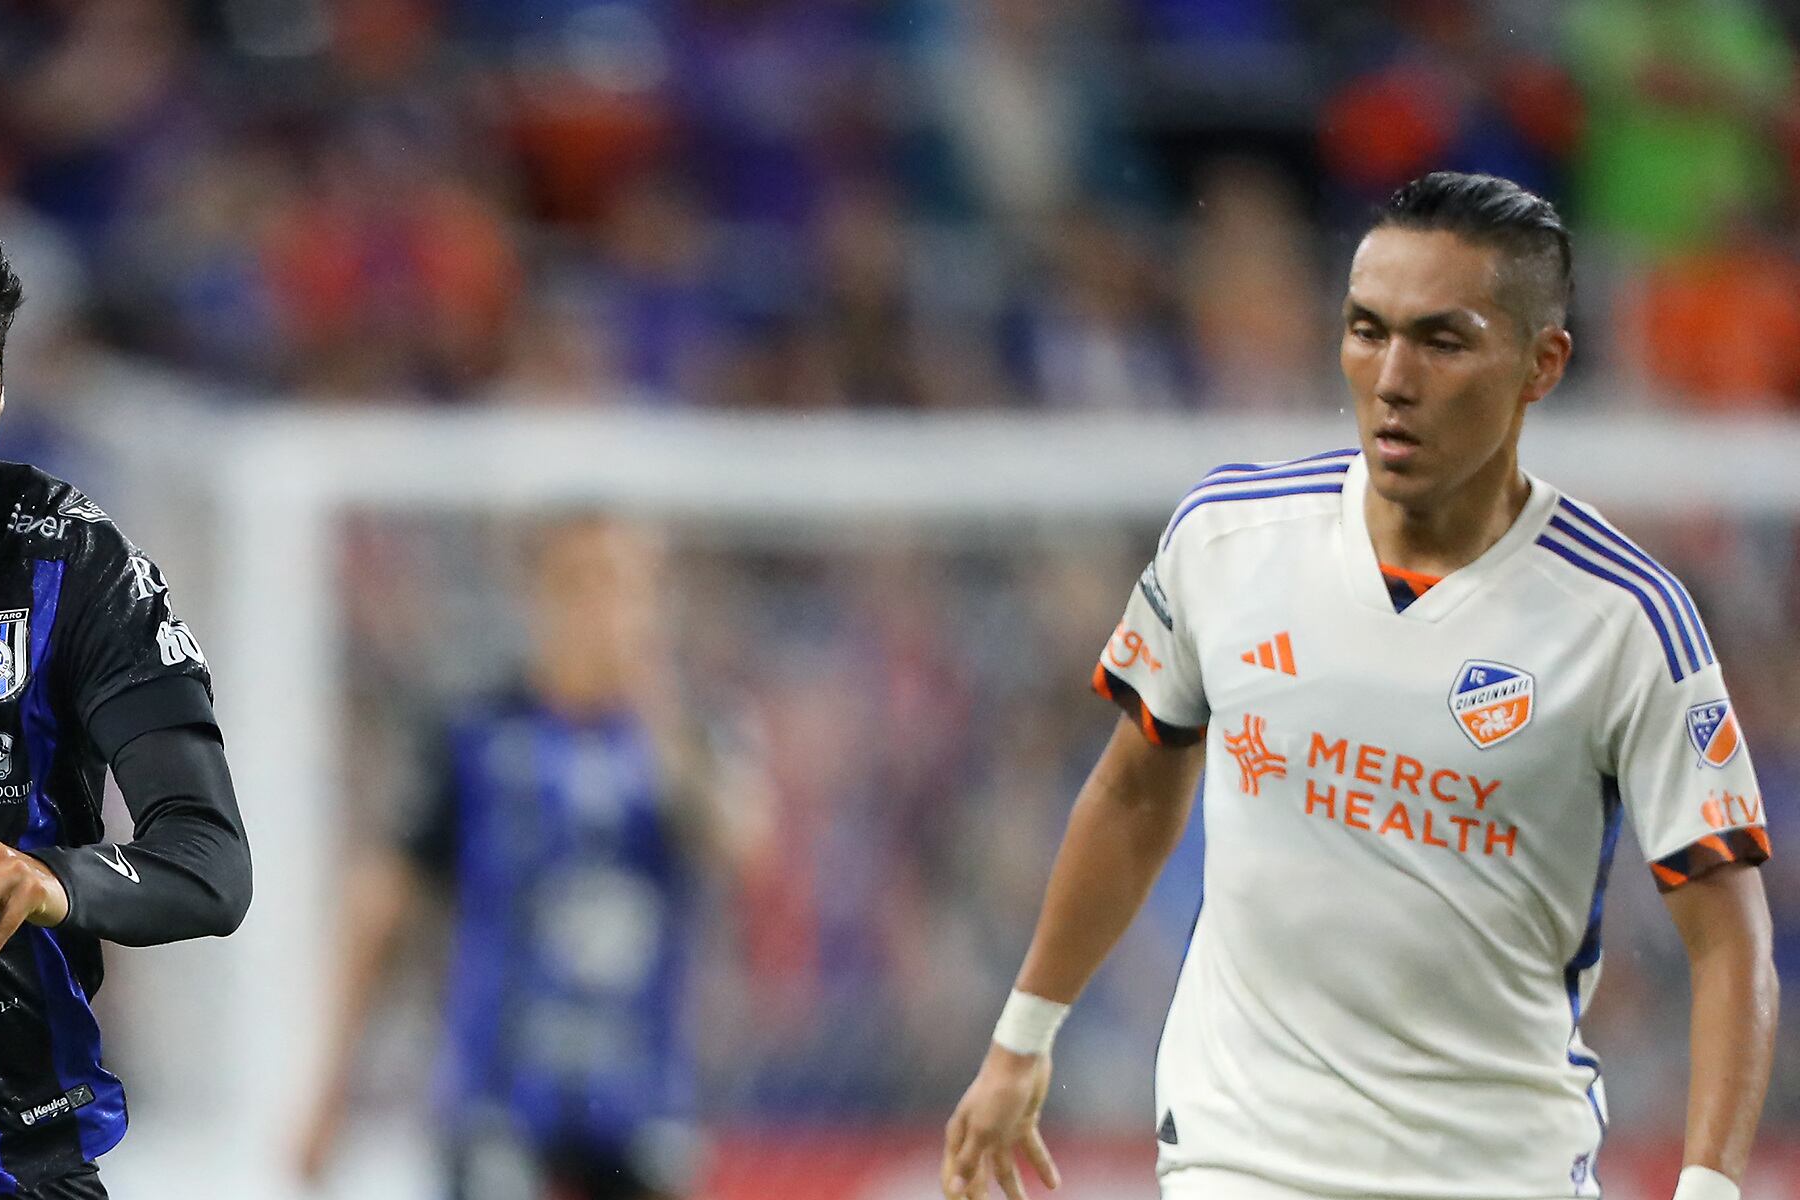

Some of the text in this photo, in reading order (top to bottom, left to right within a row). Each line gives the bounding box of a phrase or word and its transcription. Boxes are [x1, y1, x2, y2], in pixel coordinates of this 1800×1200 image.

[1468, 668, 1488, 685] FC
[1455, 678, 1530, 711] CINCINNATI
[1692, 706, 1720, 722] MLS
[1306, 731, 1503, 812] MERCY
[1304, 778, 1519, 857] HEALTH
[33, 1096, 69, 1119] Keuka
